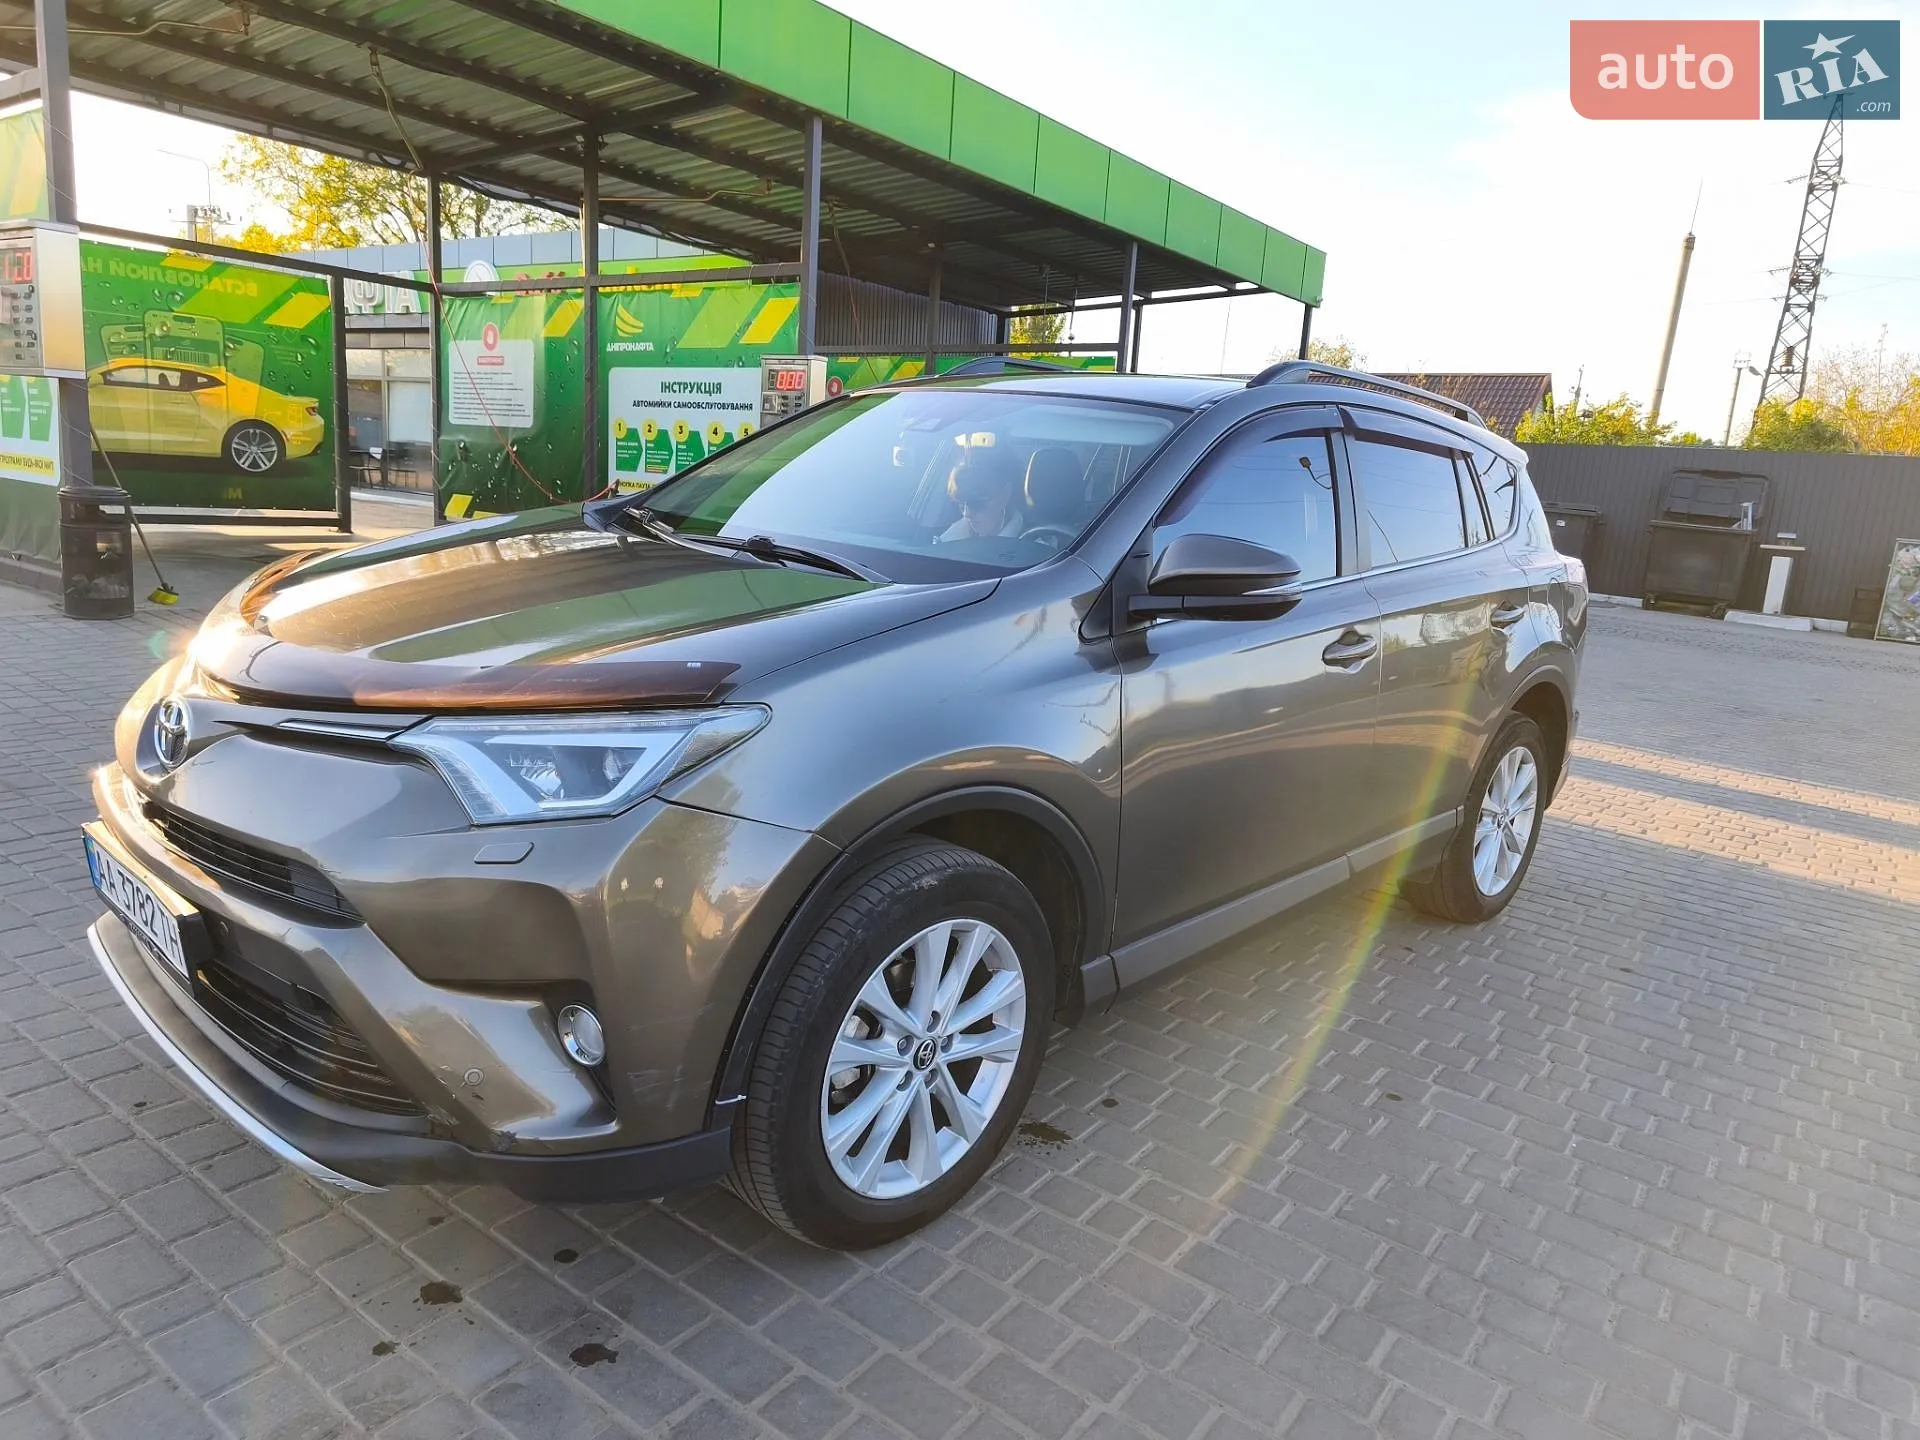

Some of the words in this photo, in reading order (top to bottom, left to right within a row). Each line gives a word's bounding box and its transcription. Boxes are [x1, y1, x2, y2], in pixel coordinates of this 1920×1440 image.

[660, 381, 722, 397] ІНСТРУКЦІЯ
[632, 399, 672, 409] АВТОМИЙКИ
[673, 400, 753, 411] САМООБСЛУГОВУВАННЯ
[647, 423, 653, 433] 2
[677, 425, 684, 435] 3
[712, 426, 719, 436] 4
[117, 868, 158, 937] 3782
